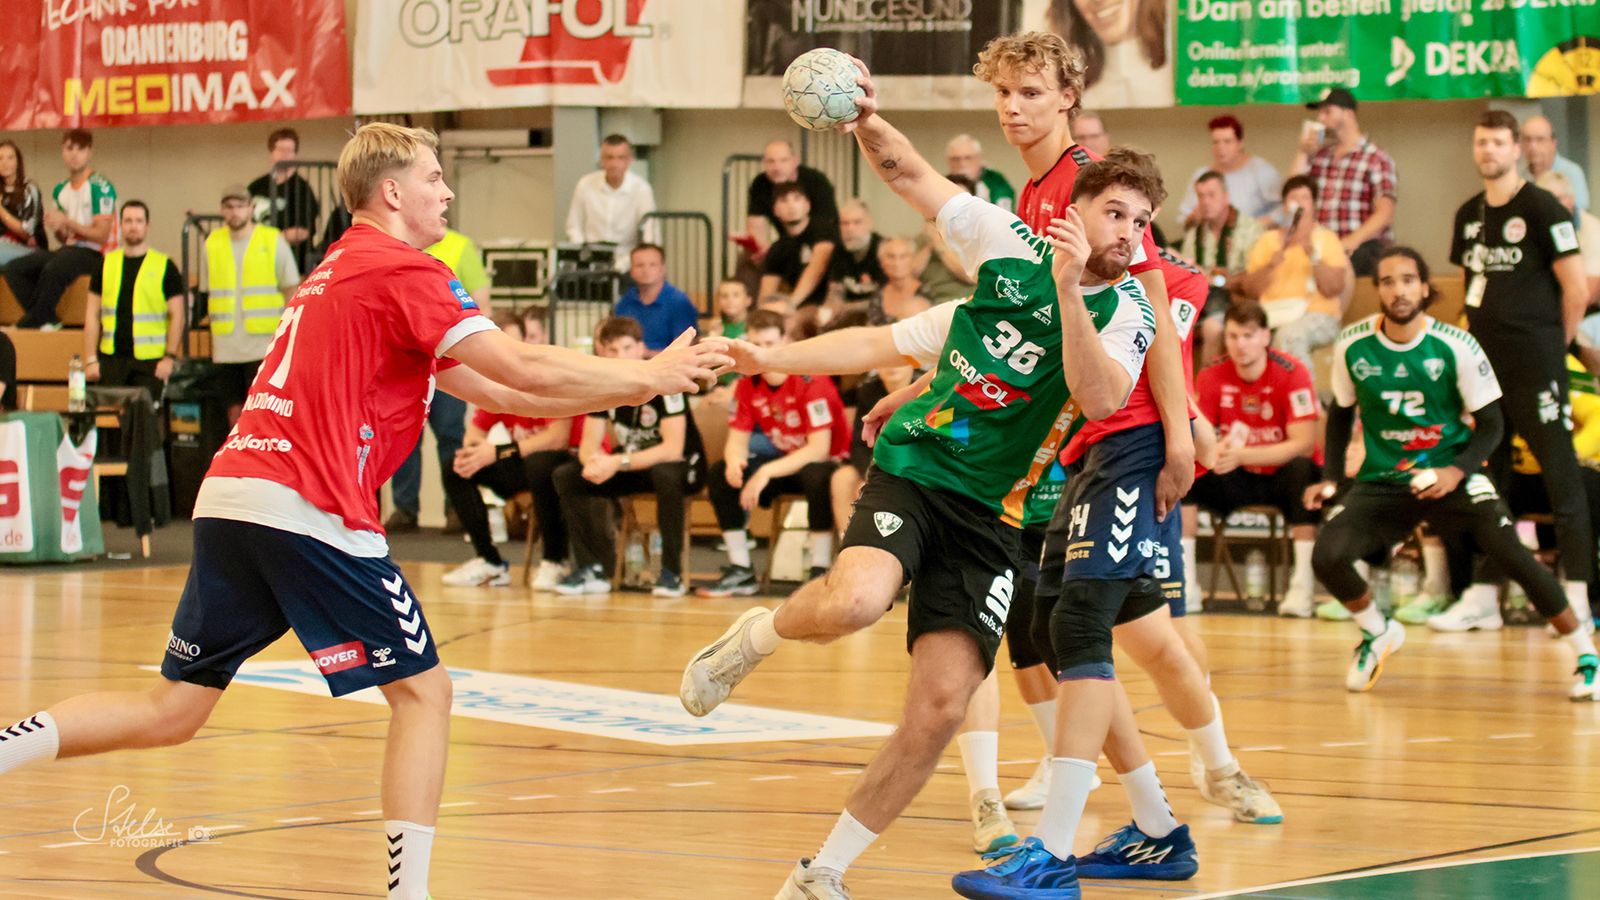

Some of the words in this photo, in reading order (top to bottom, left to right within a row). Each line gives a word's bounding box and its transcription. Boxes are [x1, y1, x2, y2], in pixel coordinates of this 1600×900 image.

[101, 20, 248, 66] ORANIENBURG
[399, 0, 653, 48] ORAFOL
[1425, 39, 1521, 76] DEKRA
[63, 68, 297, 116] MEDIMAX
[1032, 310, 1052, 326] SELECT
[982, 320, 1046, 375] 36
[949, 350, 1008, 408] ORAFOL
[1381, 391, 1426, 416] 72
[980, 612, 1003, 639] mbs.d
